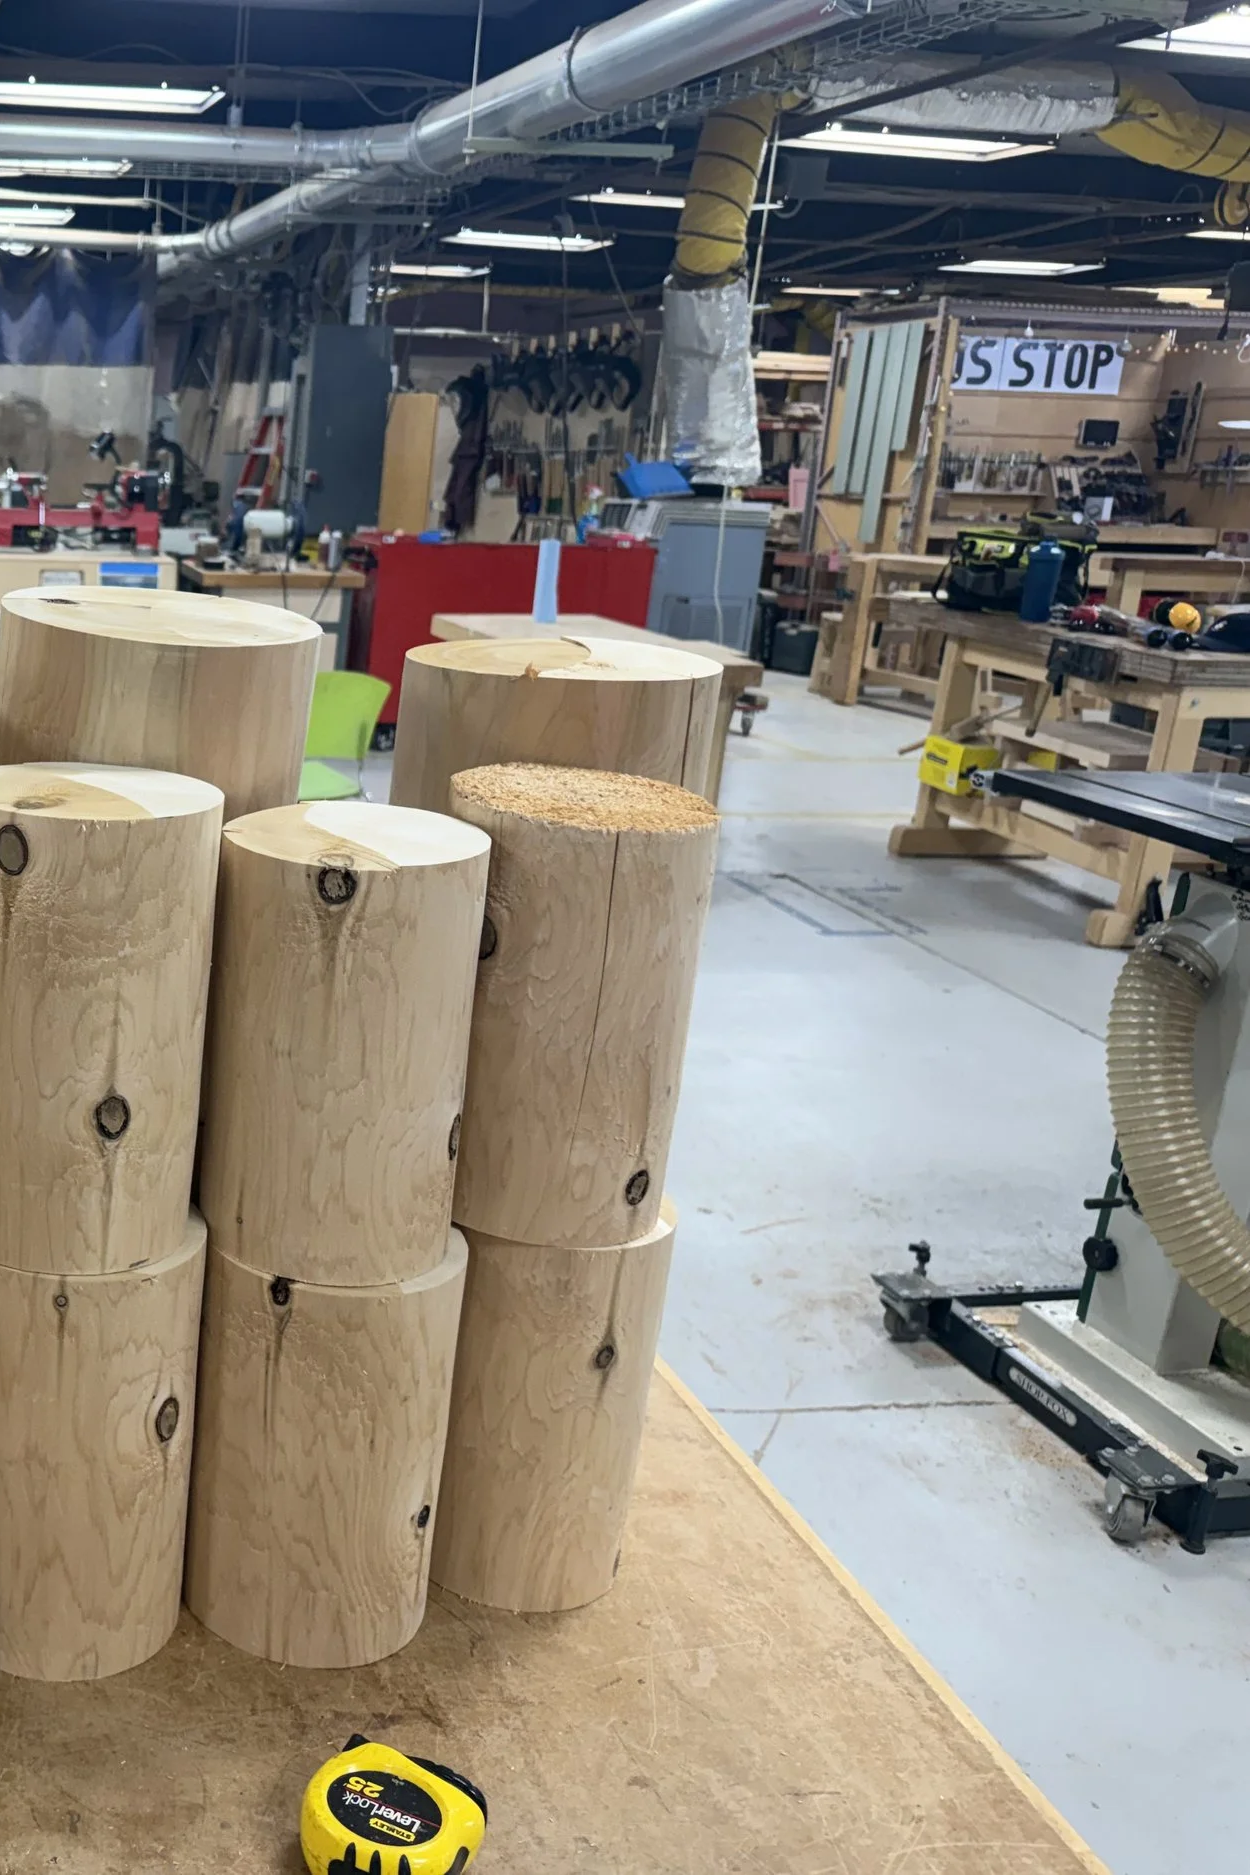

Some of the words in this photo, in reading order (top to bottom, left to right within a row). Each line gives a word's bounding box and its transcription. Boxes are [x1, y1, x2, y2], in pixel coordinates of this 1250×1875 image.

[1008, 341, 1114, 390] STOP
[1046, 1396, 1069, 1421] FOX
[372, 1820, 412, 1840] STANLEY
